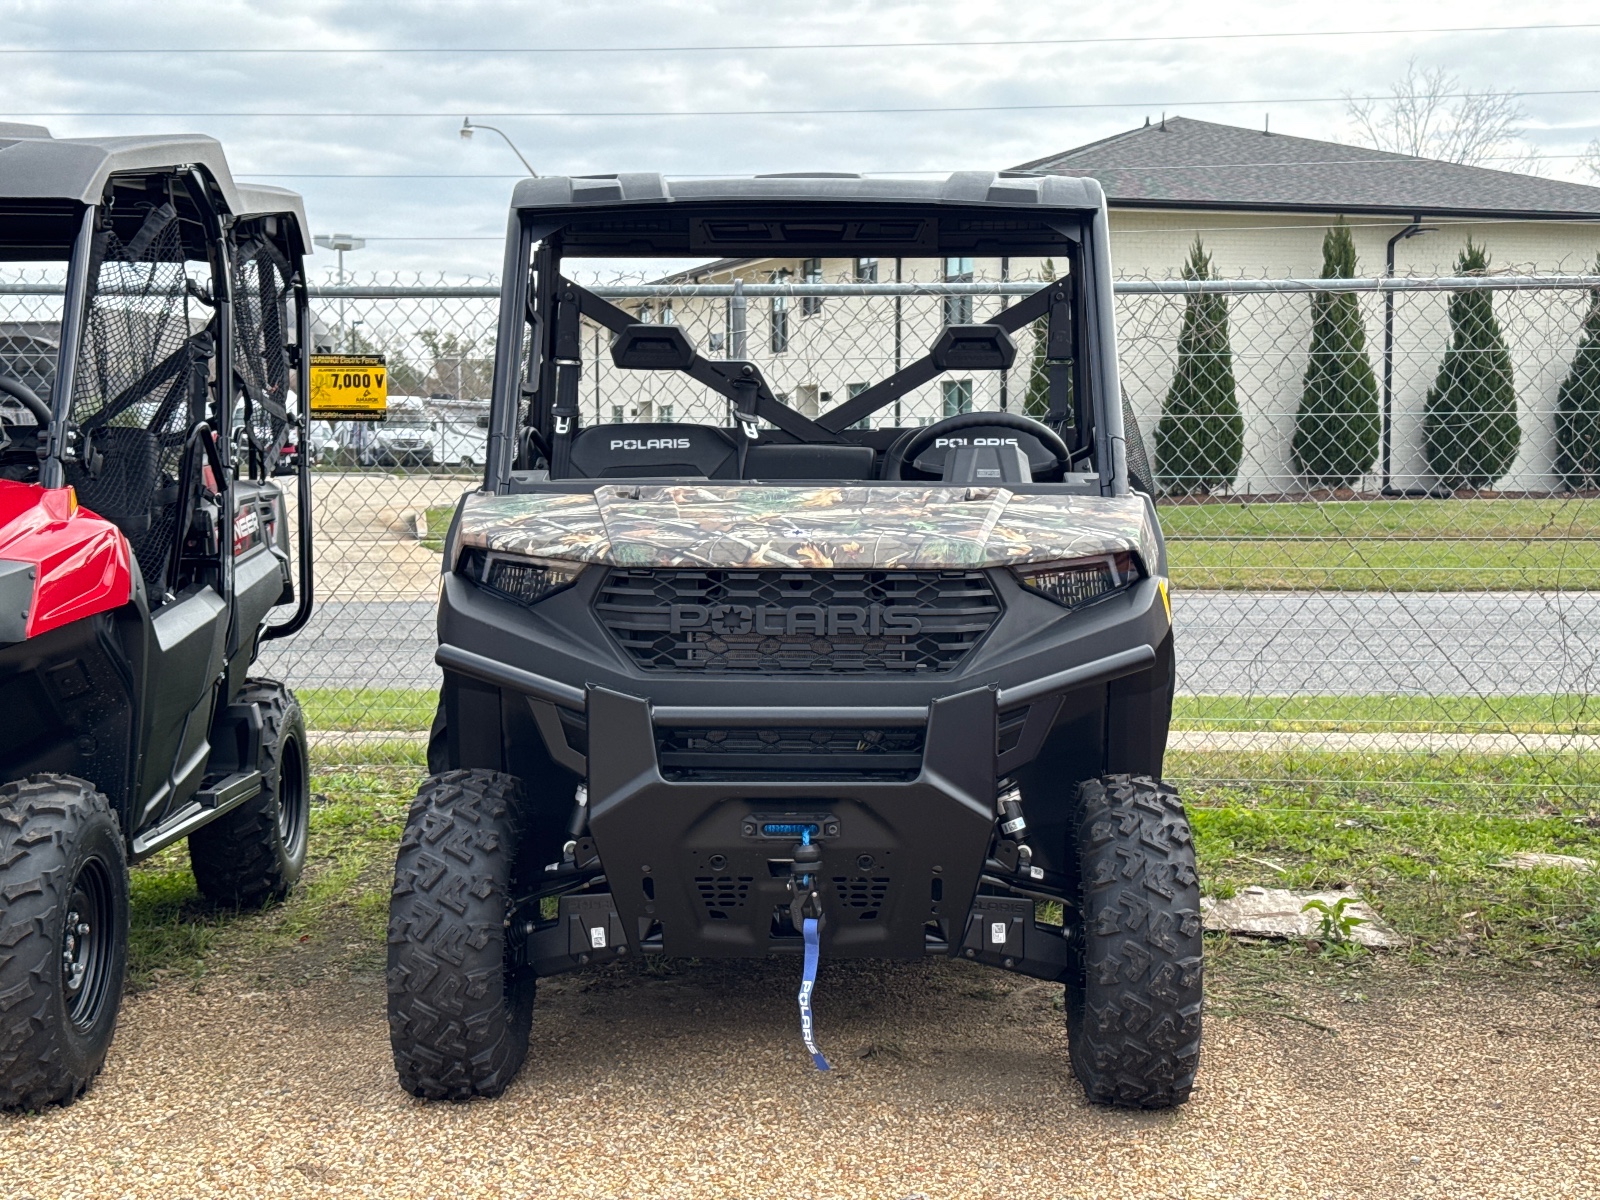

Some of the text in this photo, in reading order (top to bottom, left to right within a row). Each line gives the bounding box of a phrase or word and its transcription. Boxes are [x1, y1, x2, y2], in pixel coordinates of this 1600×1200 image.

[331, 374, 384, 390] 7,000 V
[610, 438, 690, 450] POLARIS
[670, 603, 922, 636] POLARIS
[799, 980, 819, 1054] POLARIS
